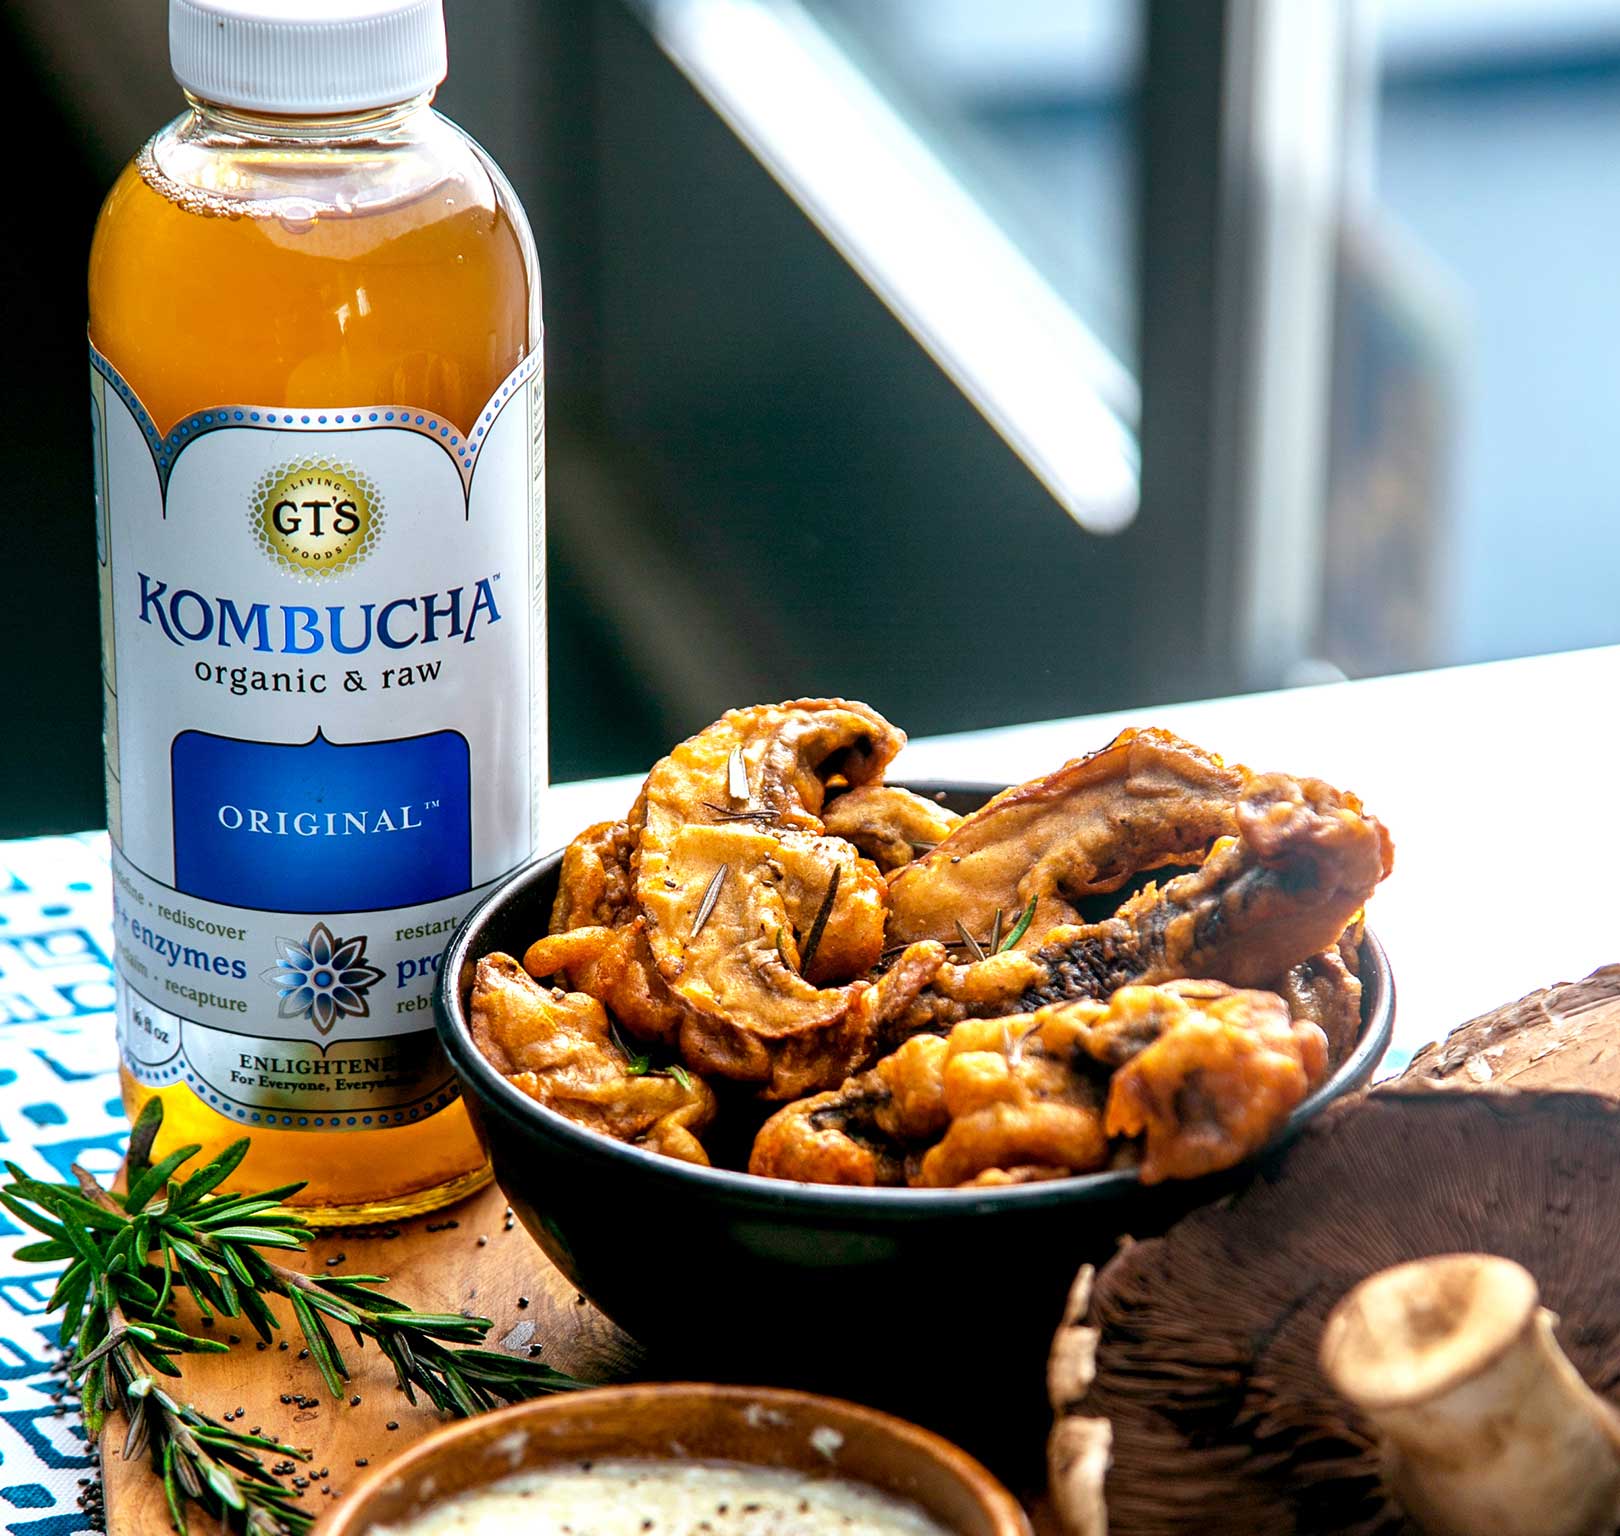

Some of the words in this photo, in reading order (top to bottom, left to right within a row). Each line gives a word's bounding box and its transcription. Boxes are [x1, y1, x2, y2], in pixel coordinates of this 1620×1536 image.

[290, 477, 342, 491] LIVING
[272, 496, 361, 537] GT'S
[291, 546, 342, 560] FOODS
[194, 661, 327, 695] organic
[343, 670, 367, 692] &
[382, 660, 442, 689] raw
[158, 904, 247, 941] rediscover
[395, 916, 457, 942] restart
[131, 918, 248, 979] enzymes
[165, 979, 248, 1012] recapture
[154, 1027, 169, 1044] oz
[230, 1070, 255, 1085] For
[258, 1075, 331, 1095] Everyone,
